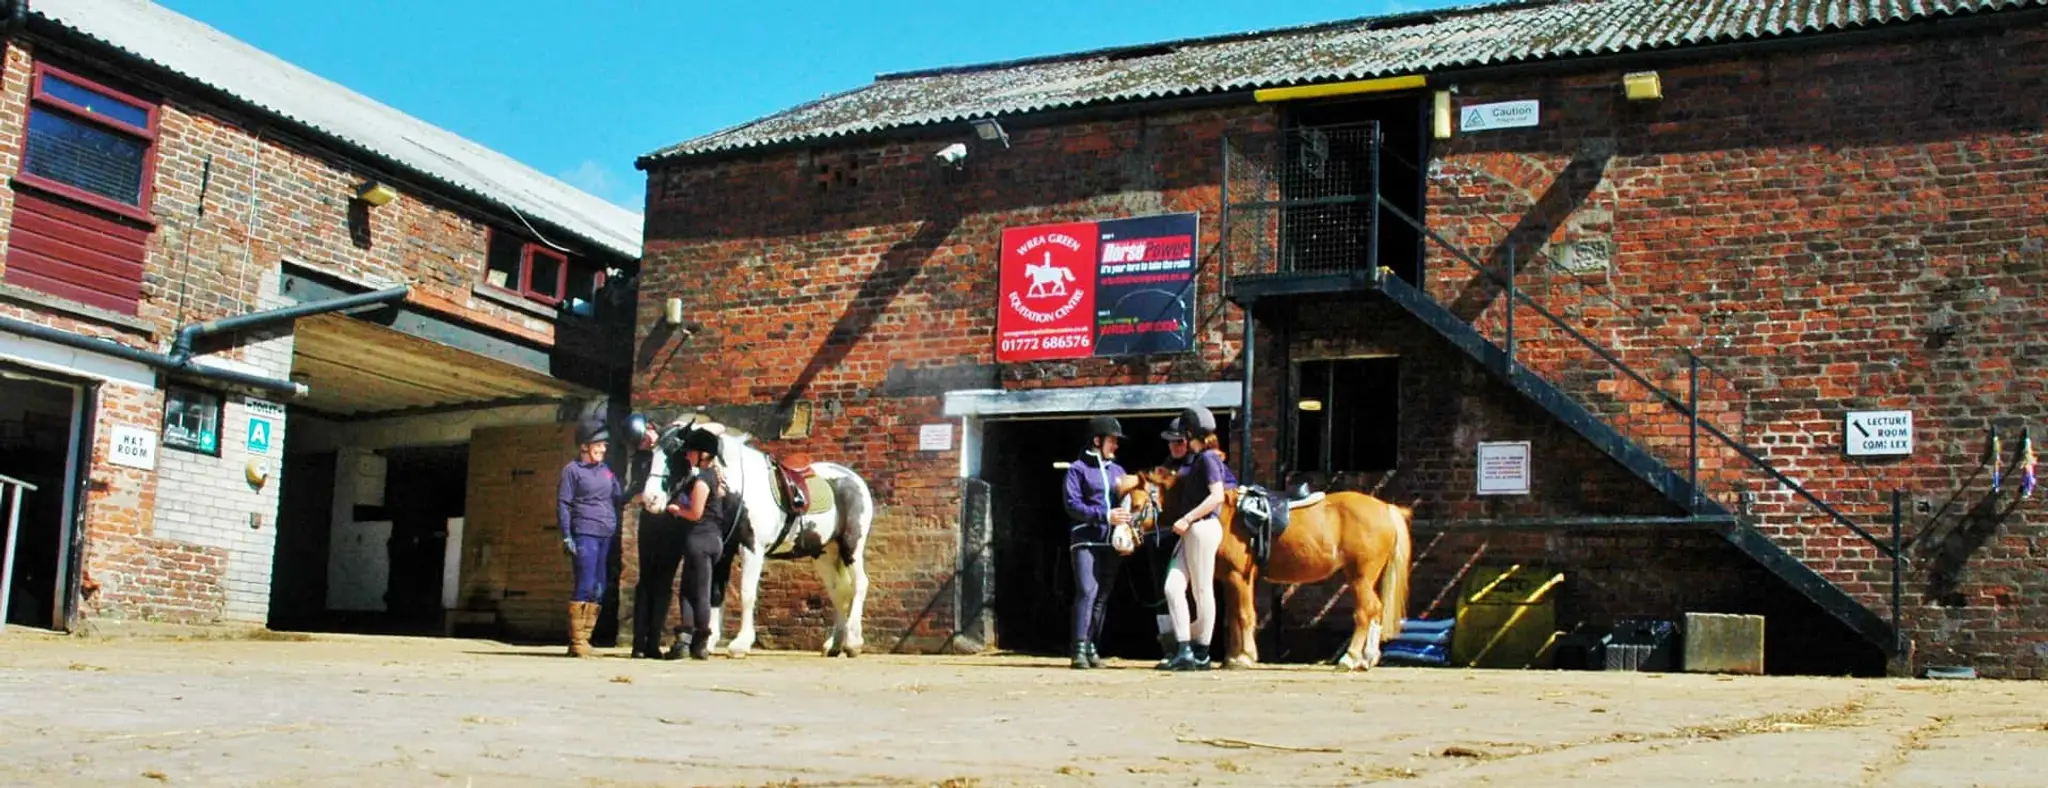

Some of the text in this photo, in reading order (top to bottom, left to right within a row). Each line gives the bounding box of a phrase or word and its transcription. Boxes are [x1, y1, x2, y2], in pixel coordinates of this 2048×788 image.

[1492, 107, 1532, 117] Caution
[1016, 233, 1081, 256] WREA GREEN
[1008, 289, 1085, 323] EQUITATION CENTRE
[1001, 335, 1090, 352] 01772 686576
[1867, 416, 1907, 426] LECTURE
[250, 422, 266, 445] A
[1877, 428, 1908, 437] ROOM
[124, 435, 144, 446] HAT
[117, 443, 148, 458] ROOM
